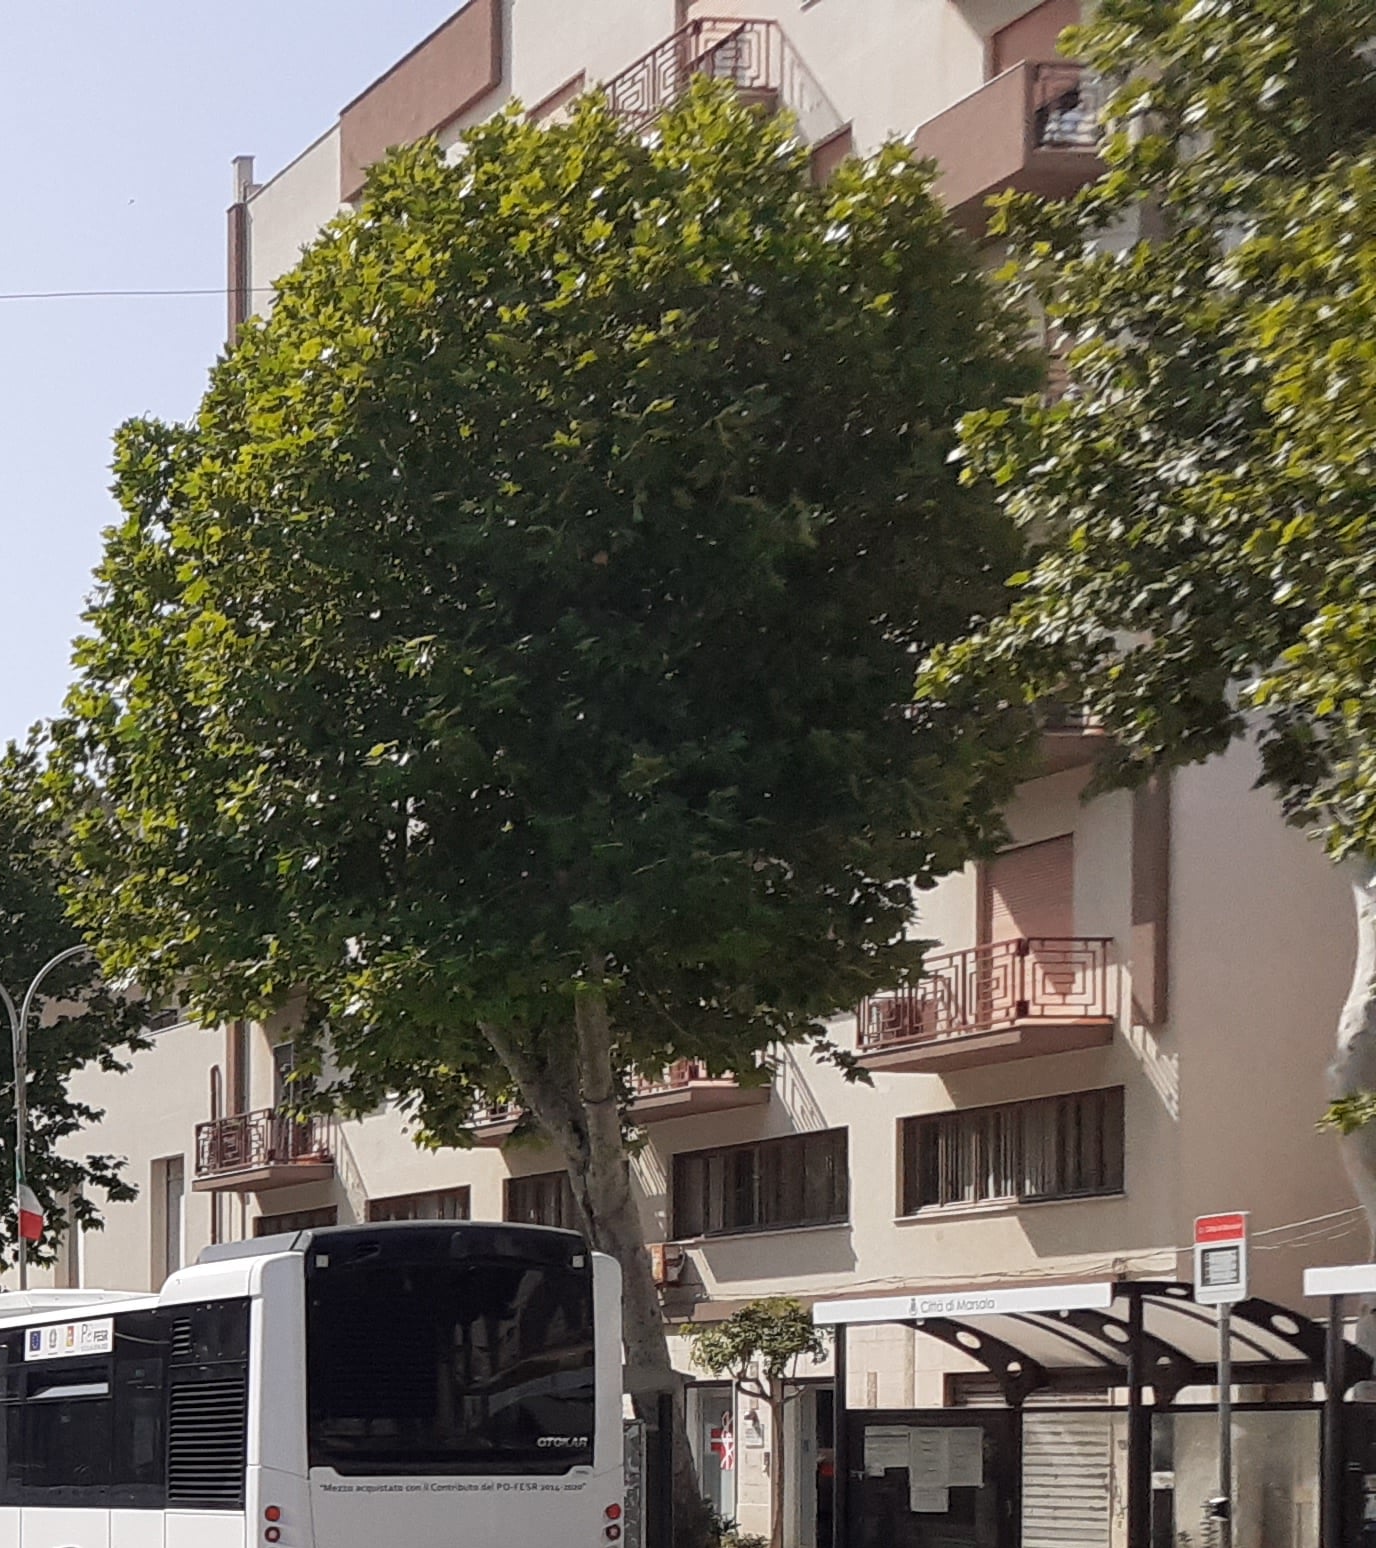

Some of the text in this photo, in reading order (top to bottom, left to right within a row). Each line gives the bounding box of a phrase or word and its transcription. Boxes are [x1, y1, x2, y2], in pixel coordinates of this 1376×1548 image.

[945, 1299, 954, 1312] di
[956, 1298, 995, 1311] Marsala
[536, 1436, 589, 1447] OTOKAR
